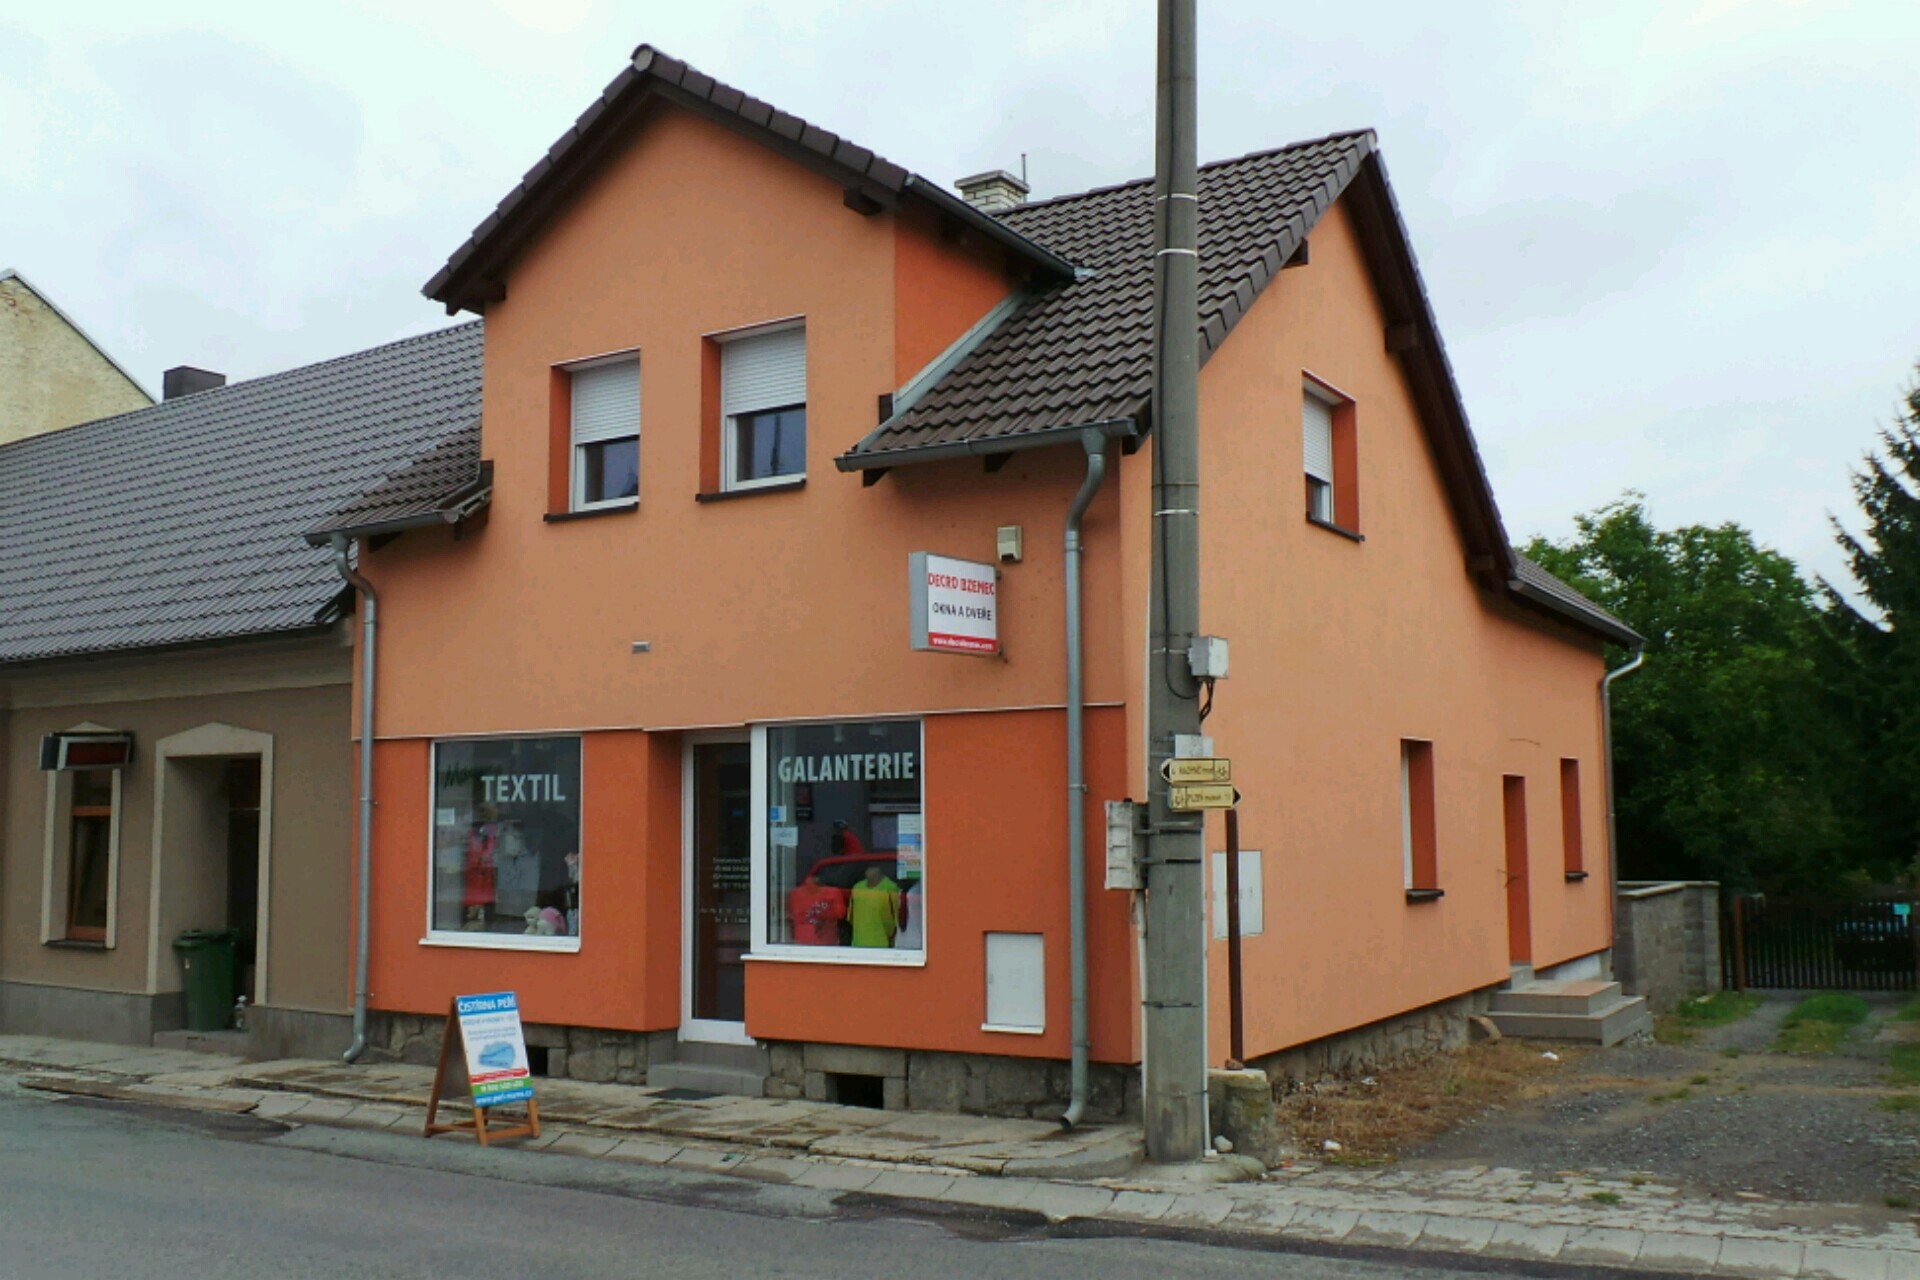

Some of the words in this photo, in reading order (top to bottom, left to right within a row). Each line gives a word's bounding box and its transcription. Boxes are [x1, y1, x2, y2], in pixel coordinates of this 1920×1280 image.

[933, 602, 957, 616] OKNA
[958, 605, 965, 617] A
[778, 752, 914, 782] GALANTERIE
[481, 774, 566, 802] TEXTIL
